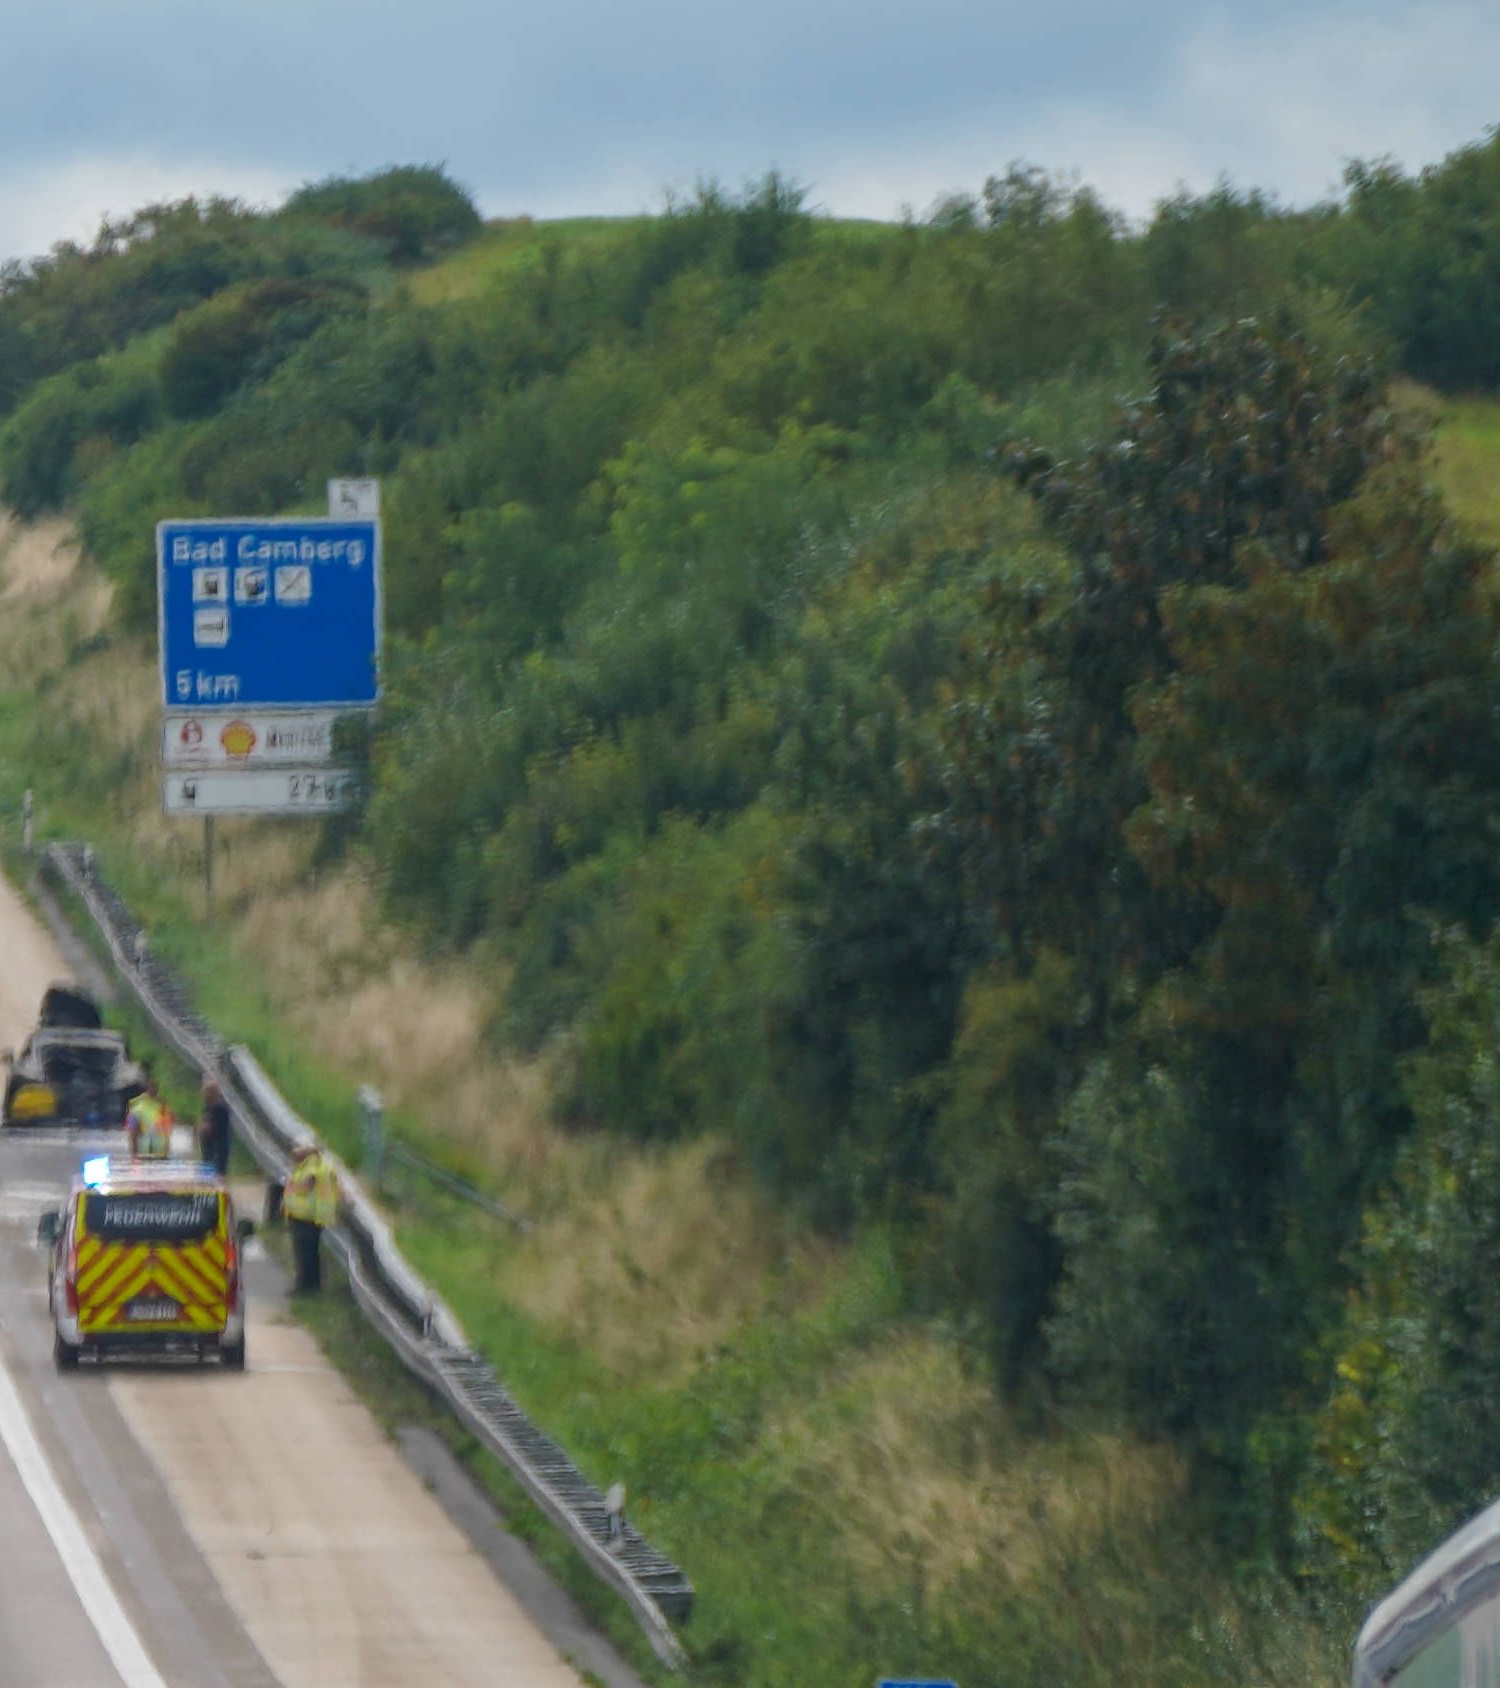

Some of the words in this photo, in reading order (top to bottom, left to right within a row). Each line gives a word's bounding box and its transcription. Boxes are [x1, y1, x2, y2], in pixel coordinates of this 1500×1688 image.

[173, 537, 224, 563] Bad
[238, 536, 364, 570] Camberg
[177, 669, 191, 698] 5
[198, 671, 239, 698] km
